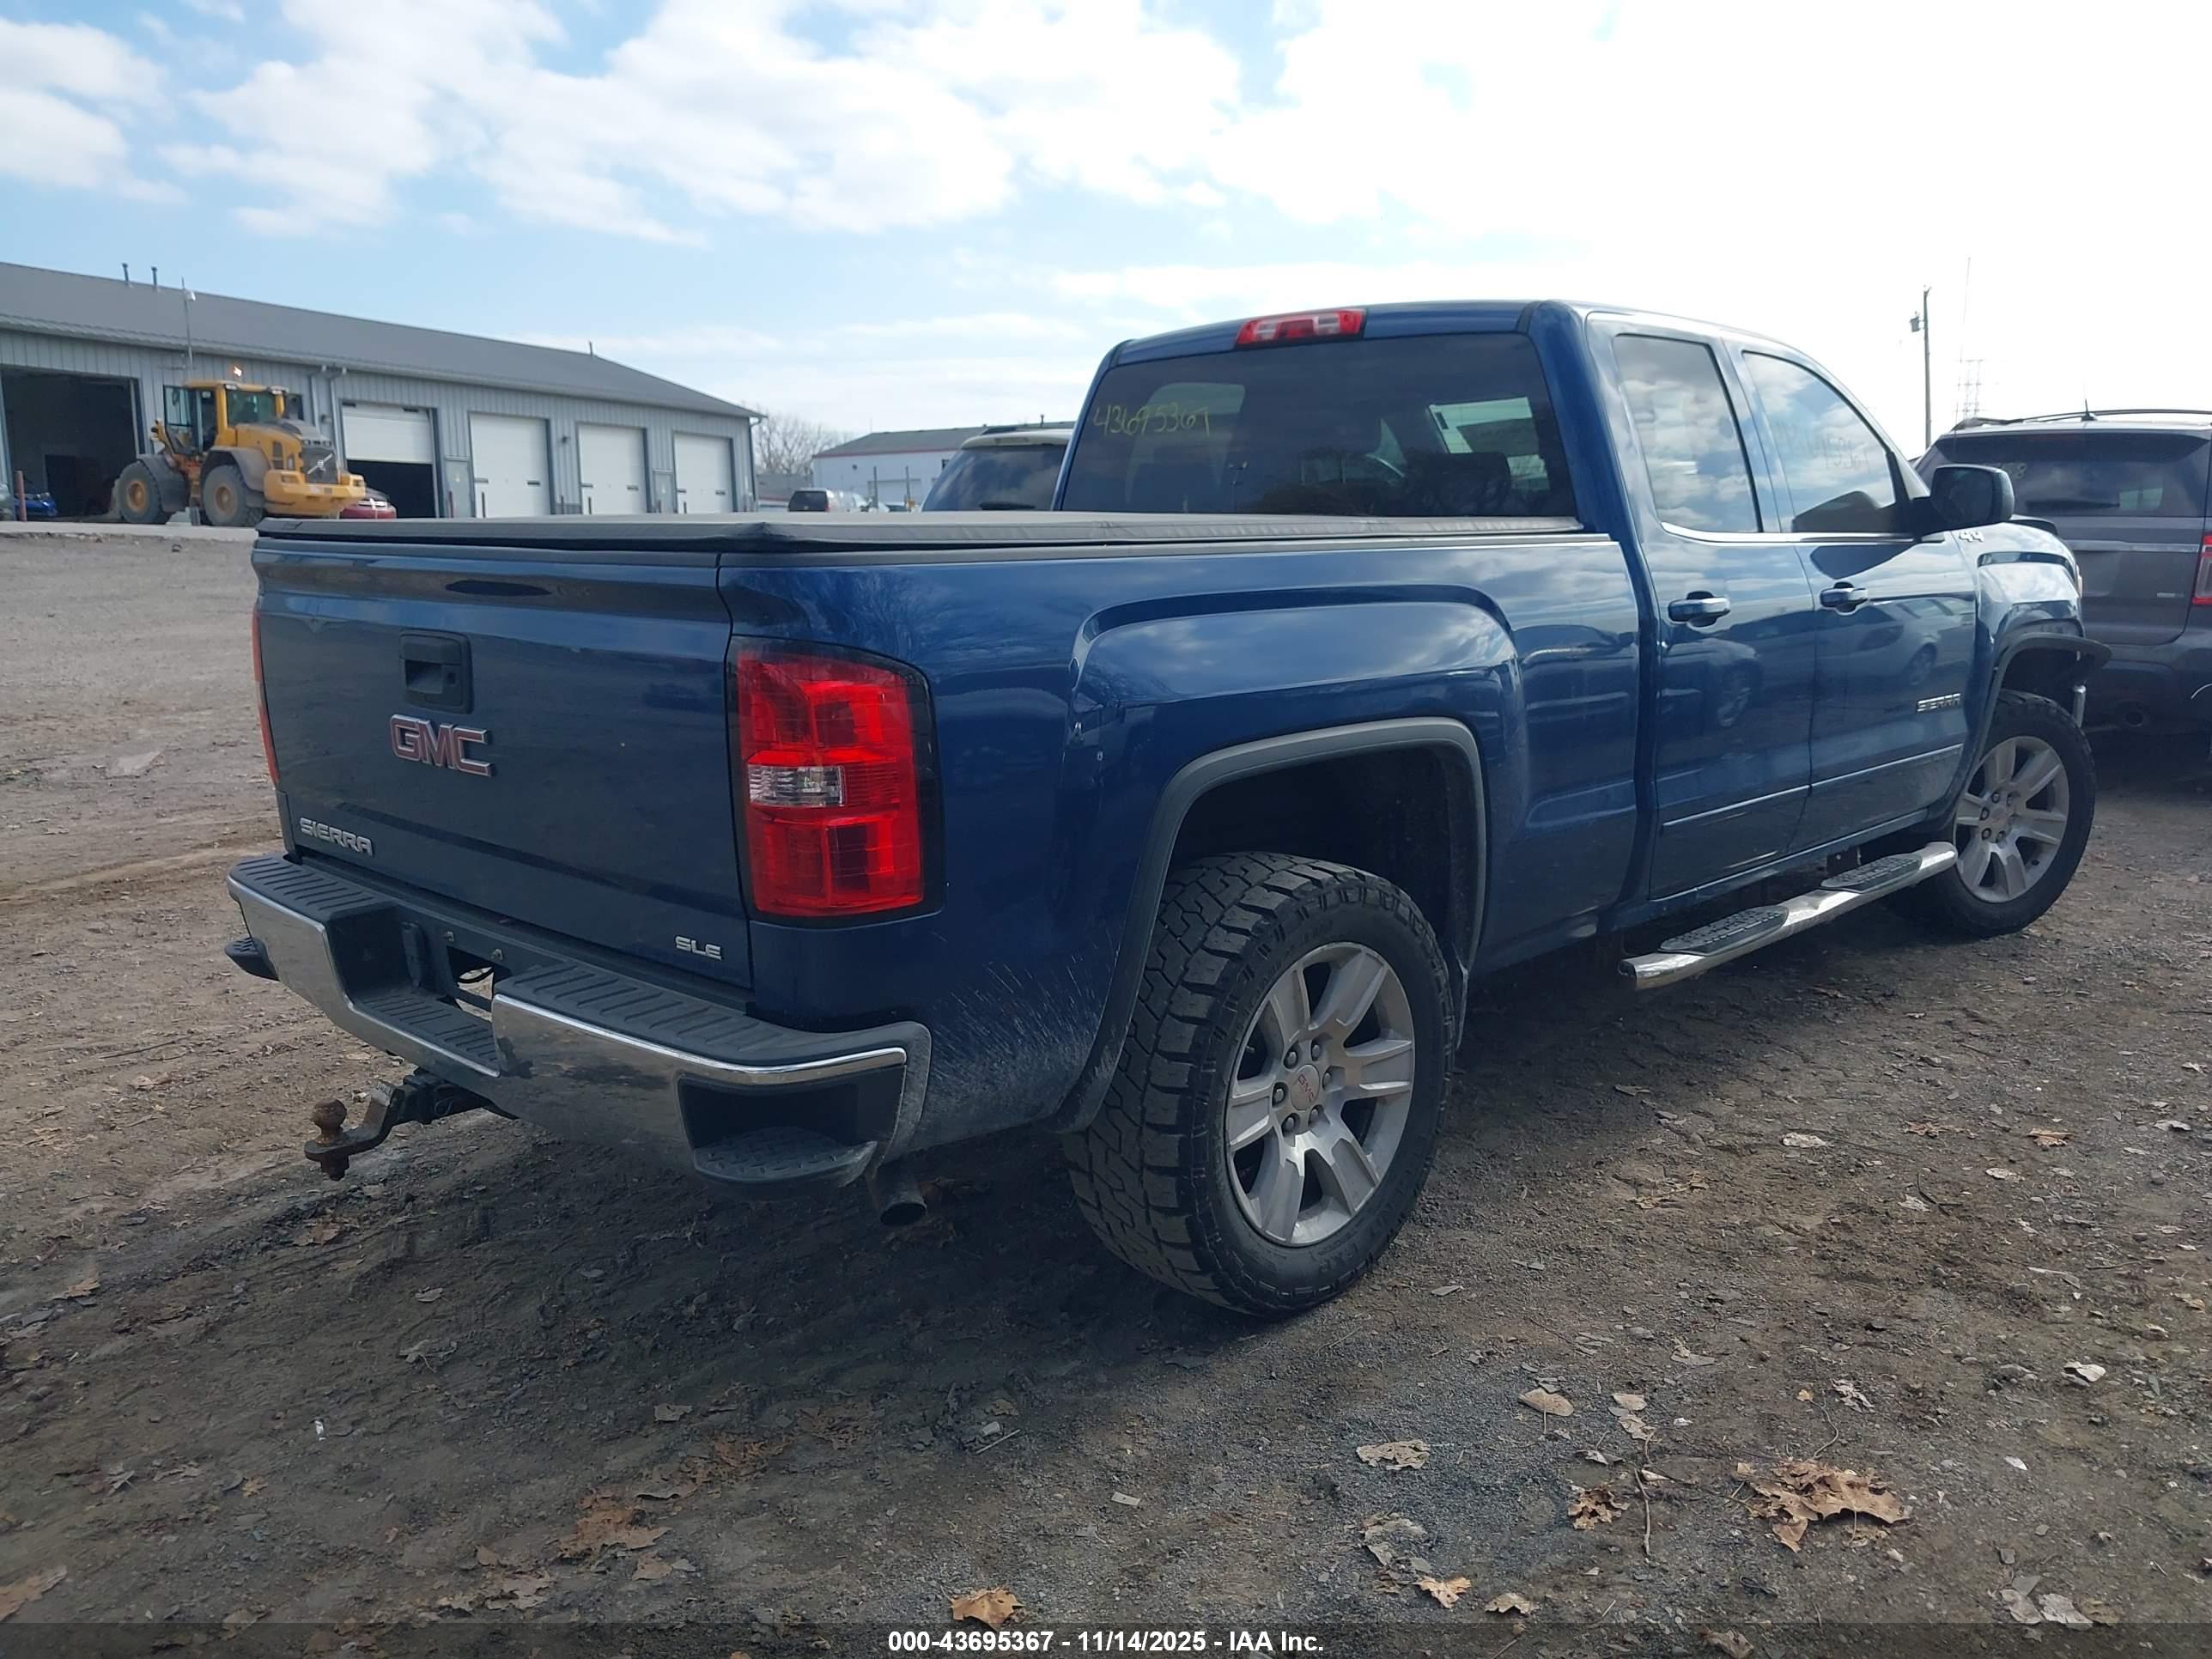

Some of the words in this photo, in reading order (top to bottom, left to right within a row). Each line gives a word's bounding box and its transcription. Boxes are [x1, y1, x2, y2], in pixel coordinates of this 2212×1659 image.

[1093, 402, 1211, 438] 43695367
[390, 714, 492, 777] GMC
[299, 817, 374, 857] SIERRA
[675, 935, 723, 961] SLE
